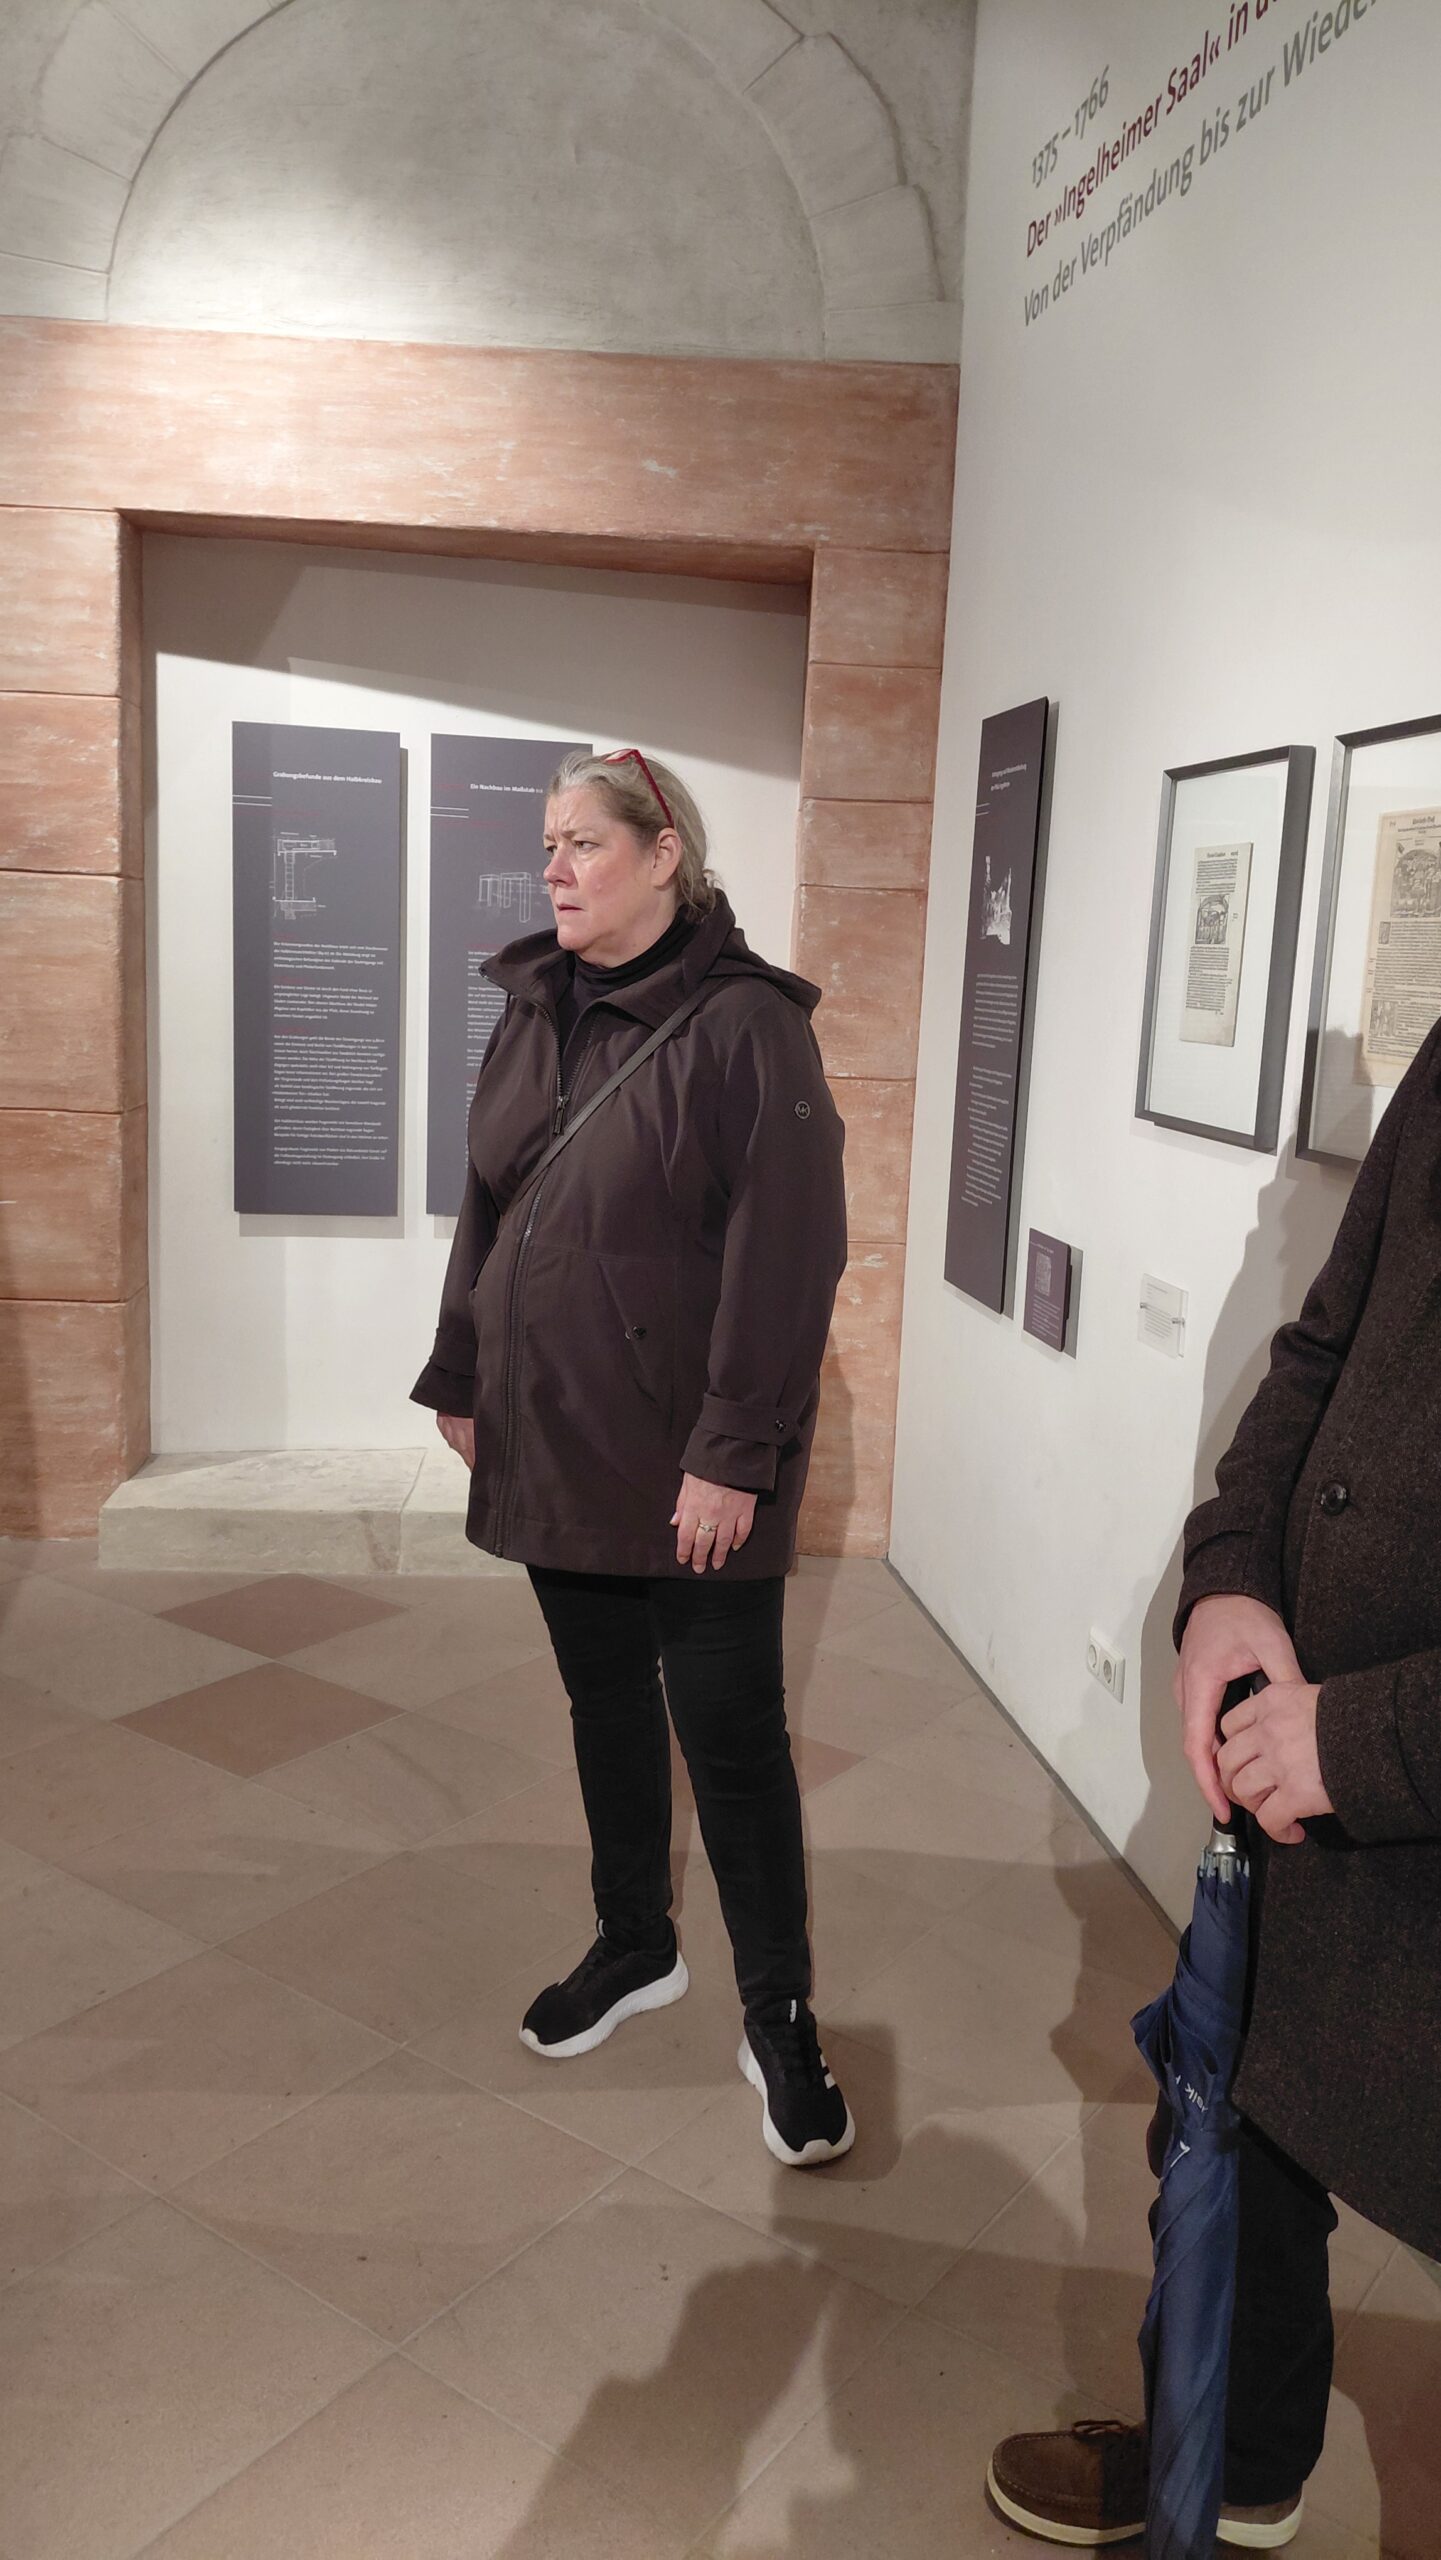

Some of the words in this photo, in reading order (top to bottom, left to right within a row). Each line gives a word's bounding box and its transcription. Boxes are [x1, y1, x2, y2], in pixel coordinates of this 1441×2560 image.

[1023, 283, 1049, 327] Von
[1052, 257, 1077, 303] der
[1080, 143, 1196, 274] Verpfändung
[1199, 106, 1229, 166] bis
[1233, 66, 1275, 132] zur
[1026, 210, 1052, 258] Der
[1053, 92, 1162, 223] »Ingelheimer
[1165, 29, 1221, 116] Saal«
[1226, 3, 1248, 52] in
[1031, 131, 1059, 188] 1375
[1073, 65, 1110, 139] 1766
